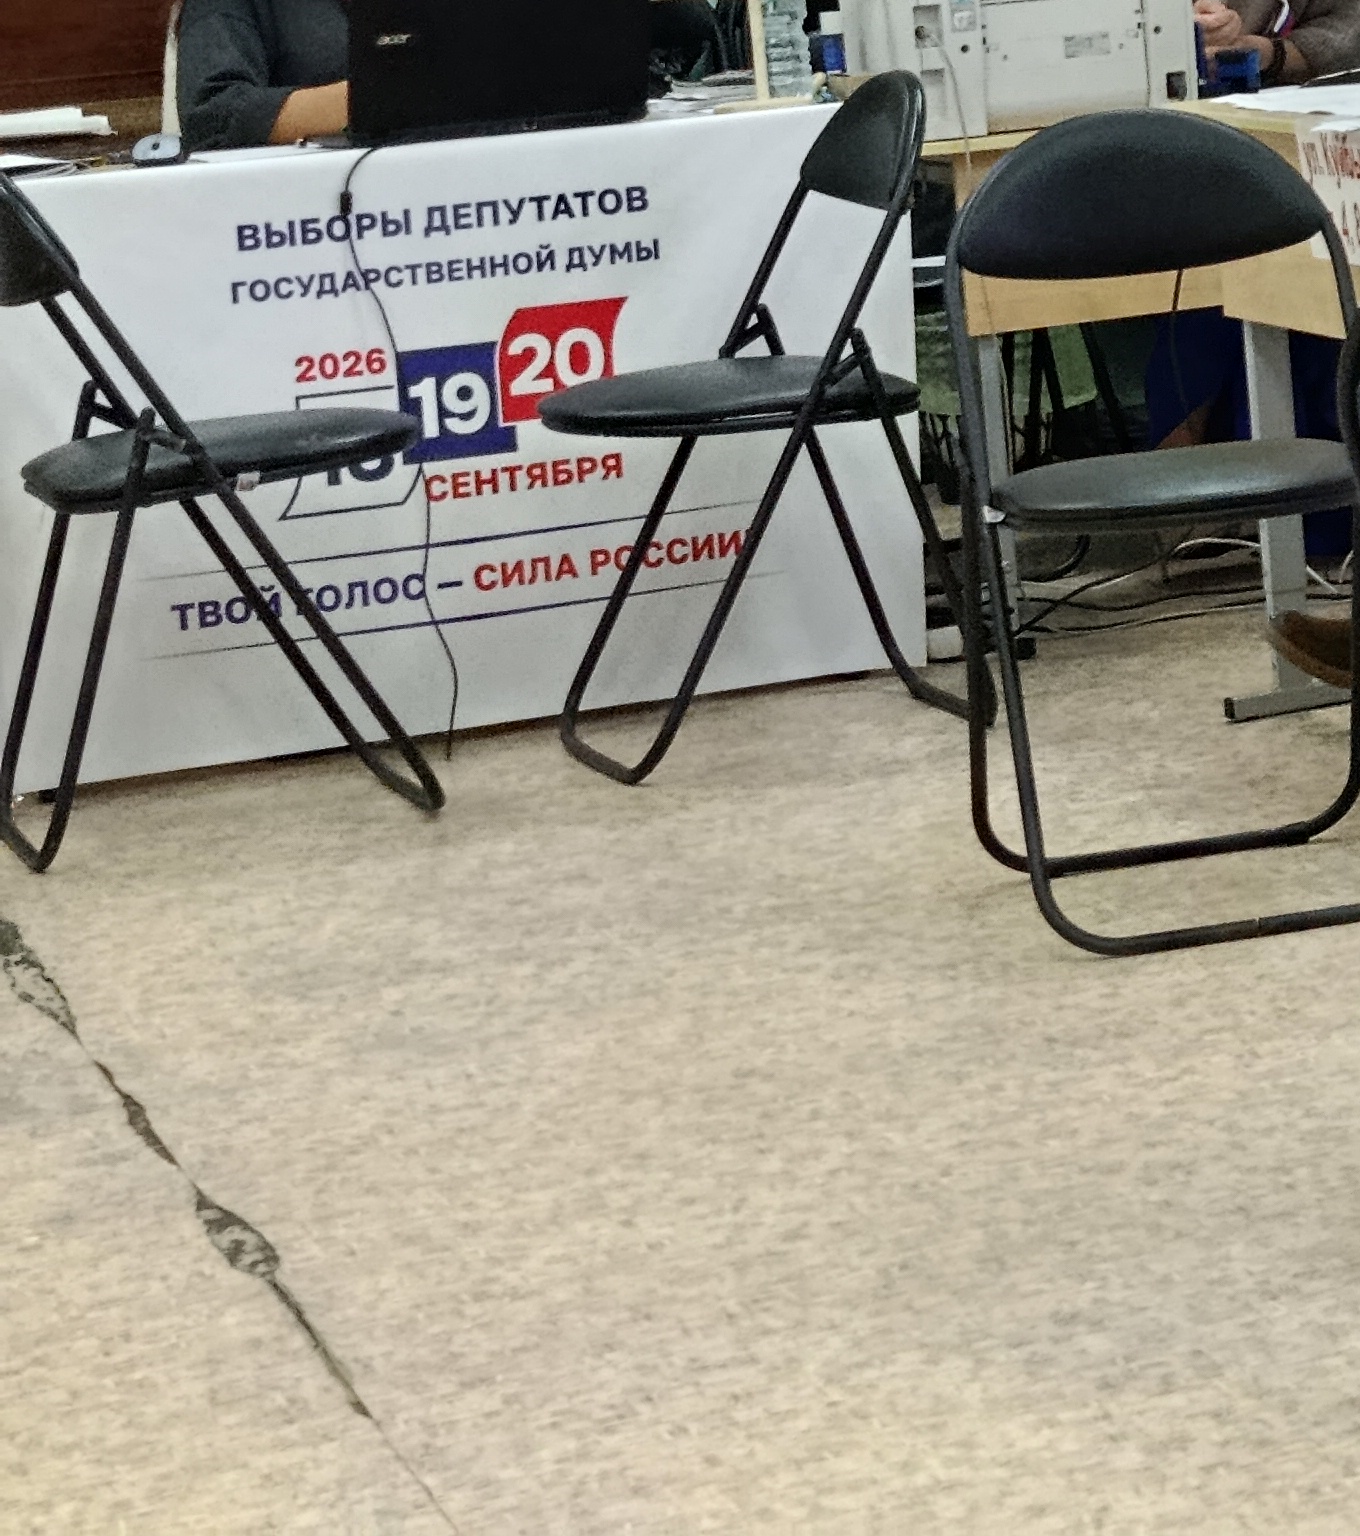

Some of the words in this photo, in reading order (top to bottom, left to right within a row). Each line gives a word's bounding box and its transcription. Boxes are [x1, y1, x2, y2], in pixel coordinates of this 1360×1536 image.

[236, 211, 412, 252] ВЫБОРЫ
[424, 185, 649, 238] ДЕПУТАТОВ
[231, 243, 557, 305] ГОСУДАРСТВЕННОЙ
[565, 238, 661, 273] ДУМЫ
[295, 347, 388, 384] 2026
[407, 370, 491, 440] 19
[507, 326, 605, 398] 20
[424, 451, 625, 504] СЕНТЯБРЯ
[473, 553, 579, 593] СИЛА
